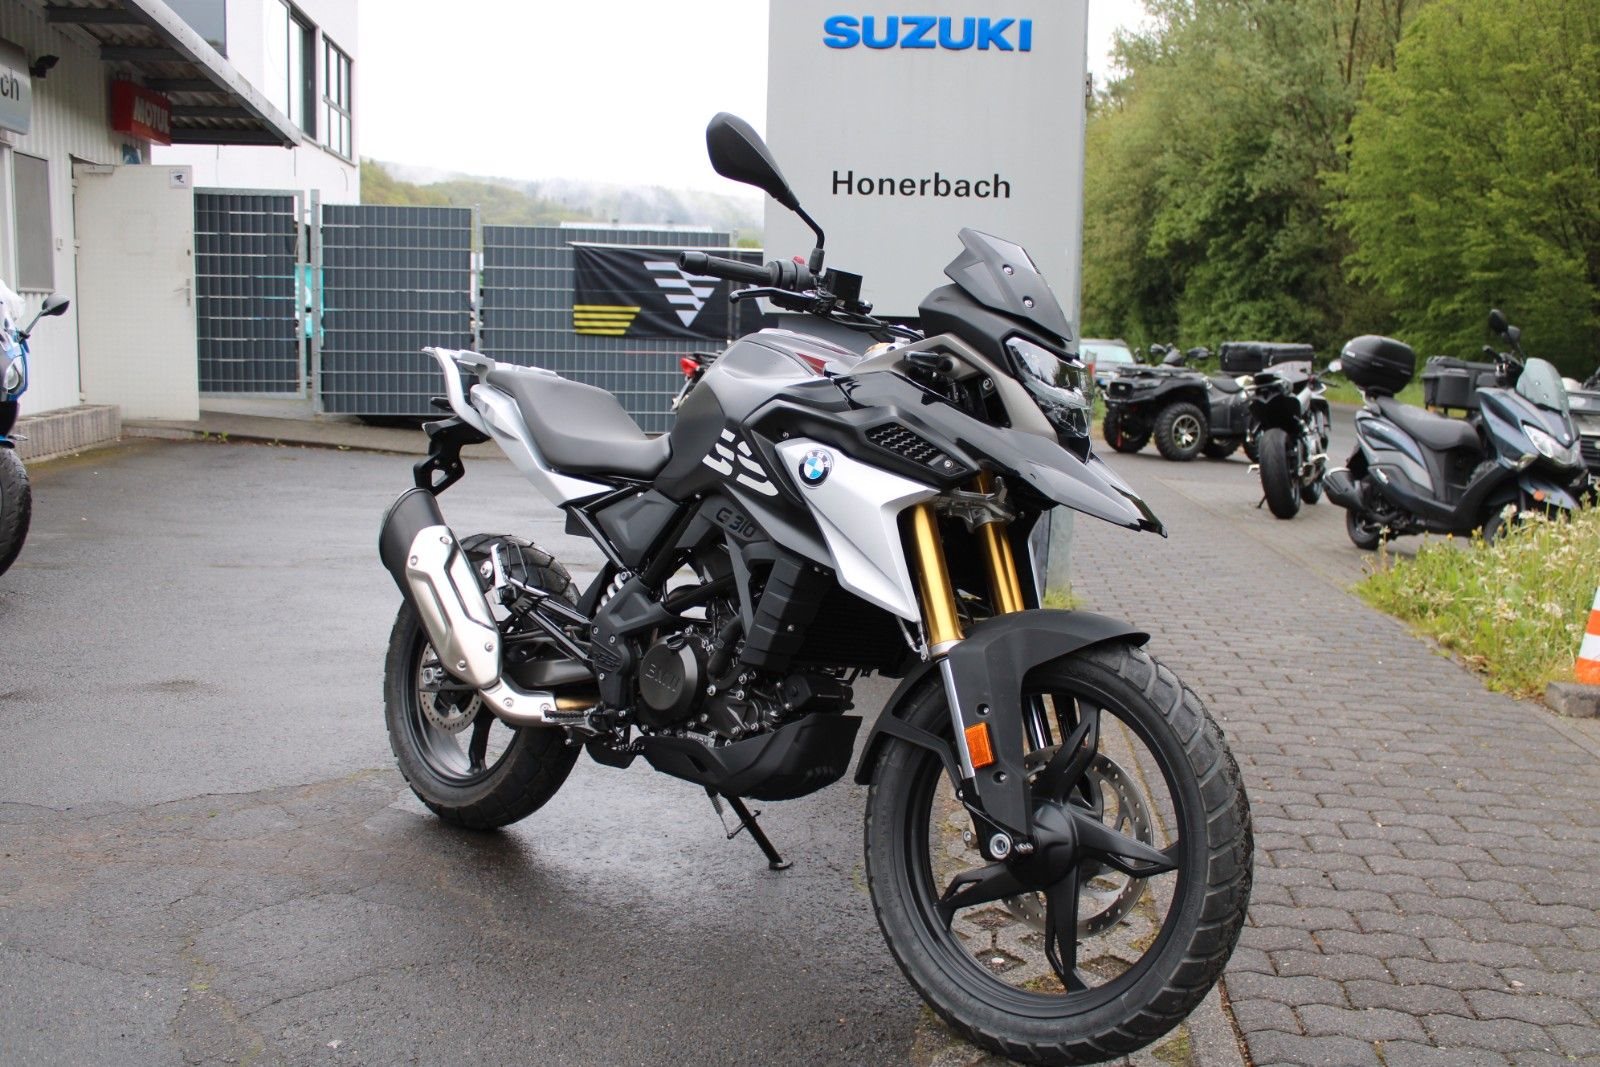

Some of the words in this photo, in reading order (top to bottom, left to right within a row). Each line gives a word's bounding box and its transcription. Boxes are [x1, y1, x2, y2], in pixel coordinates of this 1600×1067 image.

[823, 15, 1032, 52] SUZUKI
[133, 97, 170, 134] MOTUL
[832, 170, 1011, 198] Honerbach
